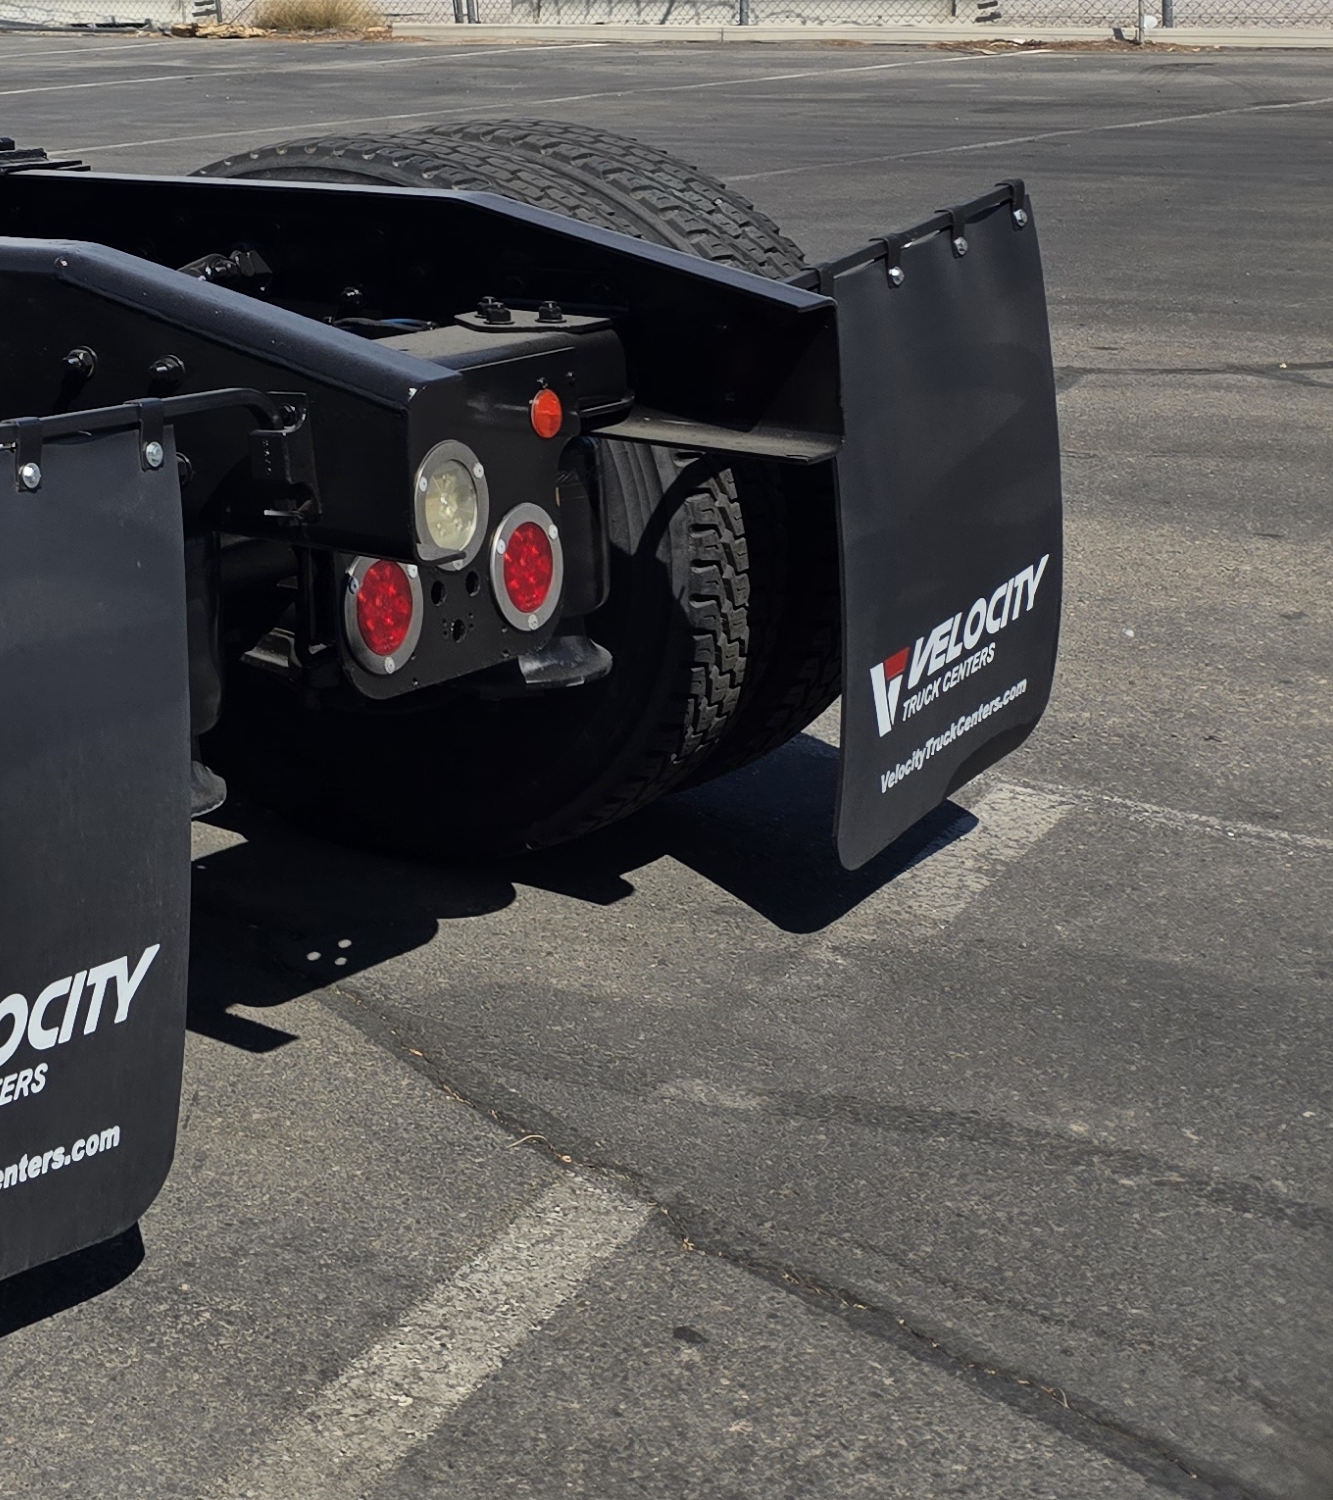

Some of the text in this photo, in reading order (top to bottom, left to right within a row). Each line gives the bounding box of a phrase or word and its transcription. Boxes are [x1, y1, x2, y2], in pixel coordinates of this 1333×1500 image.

[907, 553, 1050, 690] VELOCITY
[880, 678, 1028, 794] VelocityTruckCenters.com
[902, 641, 997, 722] TRUCK CENTERS
